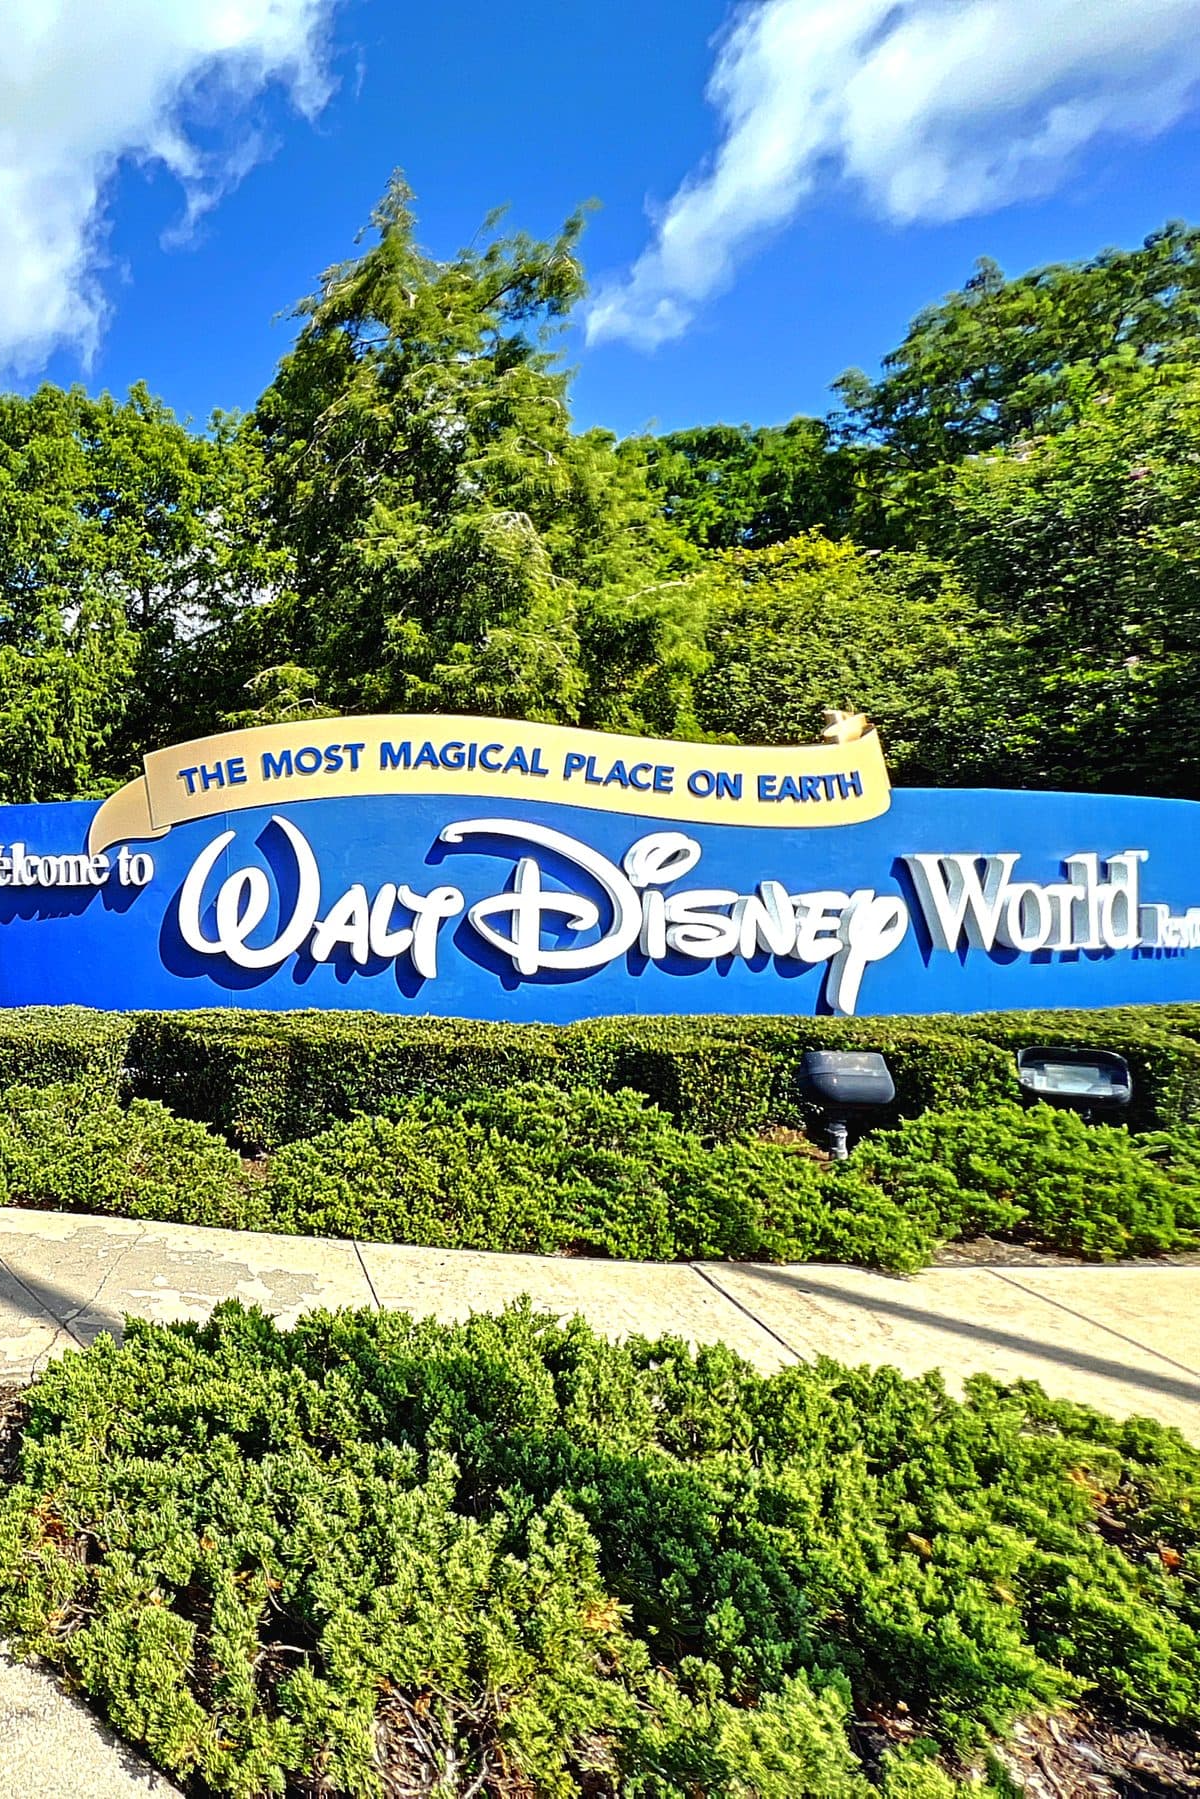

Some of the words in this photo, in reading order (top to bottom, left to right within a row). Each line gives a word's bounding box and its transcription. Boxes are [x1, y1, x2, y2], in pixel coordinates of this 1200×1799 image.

[178, 757, 248, 795] THE
[261, 742, 365, 781] MOST
[379, 740, 550, 777] MAGICAL
[563, 752, 675, 794] PLACE
[687, 769, 743, 801] ON
[757, 770, 864, 803] EARTH
[117, 846, 155, 887] to
[898, 849, 1150, 953] World
